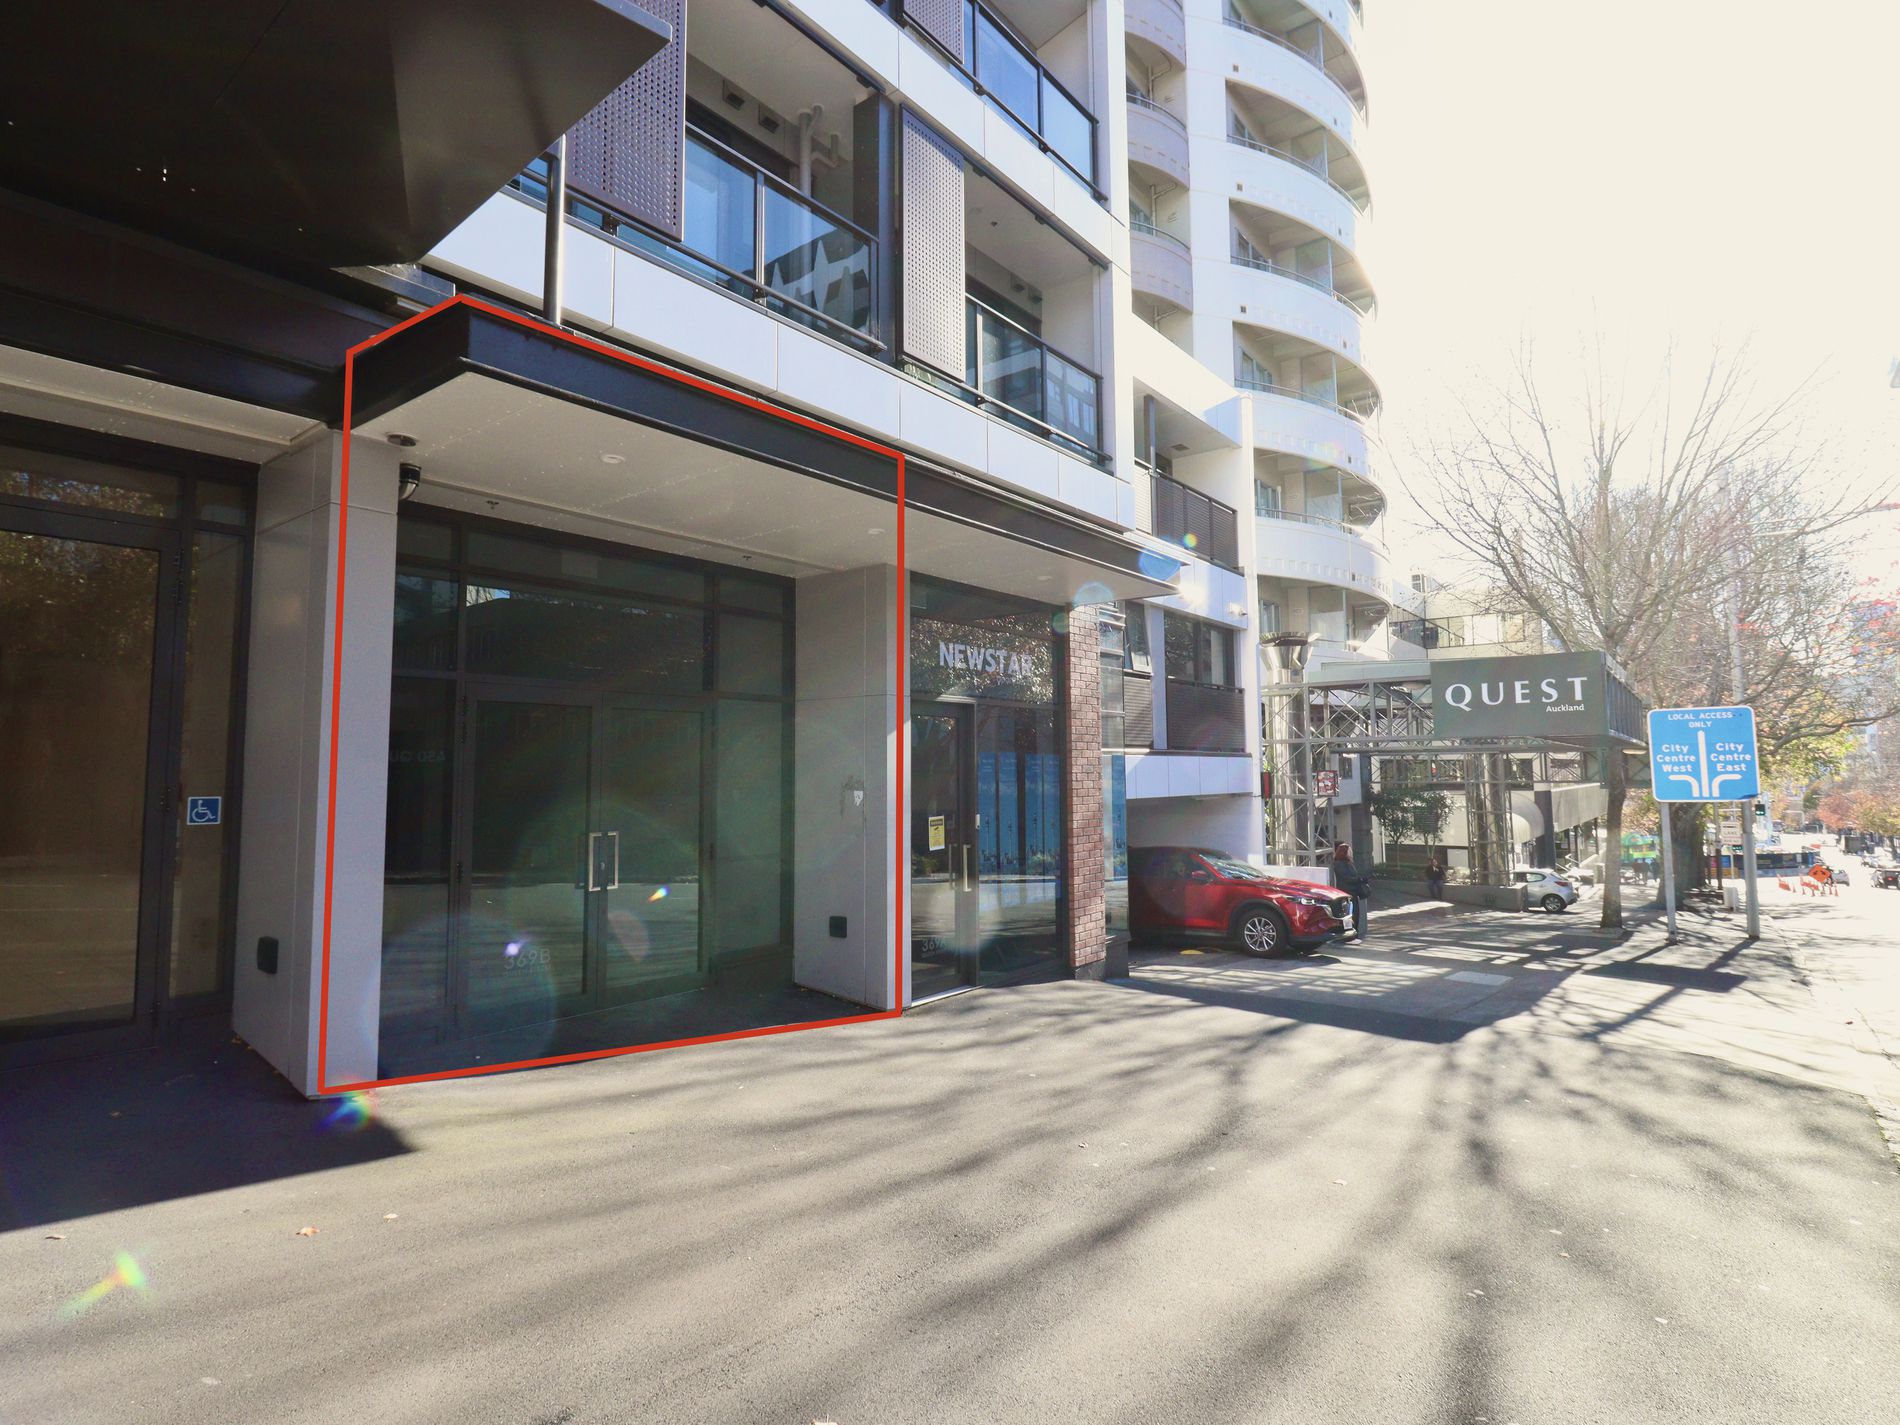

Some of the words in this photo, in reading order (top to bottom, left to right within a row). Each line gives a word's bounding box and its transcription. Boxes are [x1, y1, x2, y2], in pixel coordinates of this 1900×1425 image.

[939, 641, 1033, 676] NEWSTAR
[1444, 676, 1588, 712] QUEST
[1545, 703, 1586, 713] Auckland
[1667, 712, 1695, 720] LOCAL
[1698, 711, 1733, 719] ACCESS
[1688, 720, 1712, 728] ONLY
[1661, 744, 1689, 754] City
[1715, 742, 1744, 753] City
[1656, 754, 1696, 763] Centre
[1710, 753, 1752, 762] Centre
[1661, 764, 1693, 773] West
[1716, 763, 1747, 772] East
[503, 948, 551, 970] 369B
